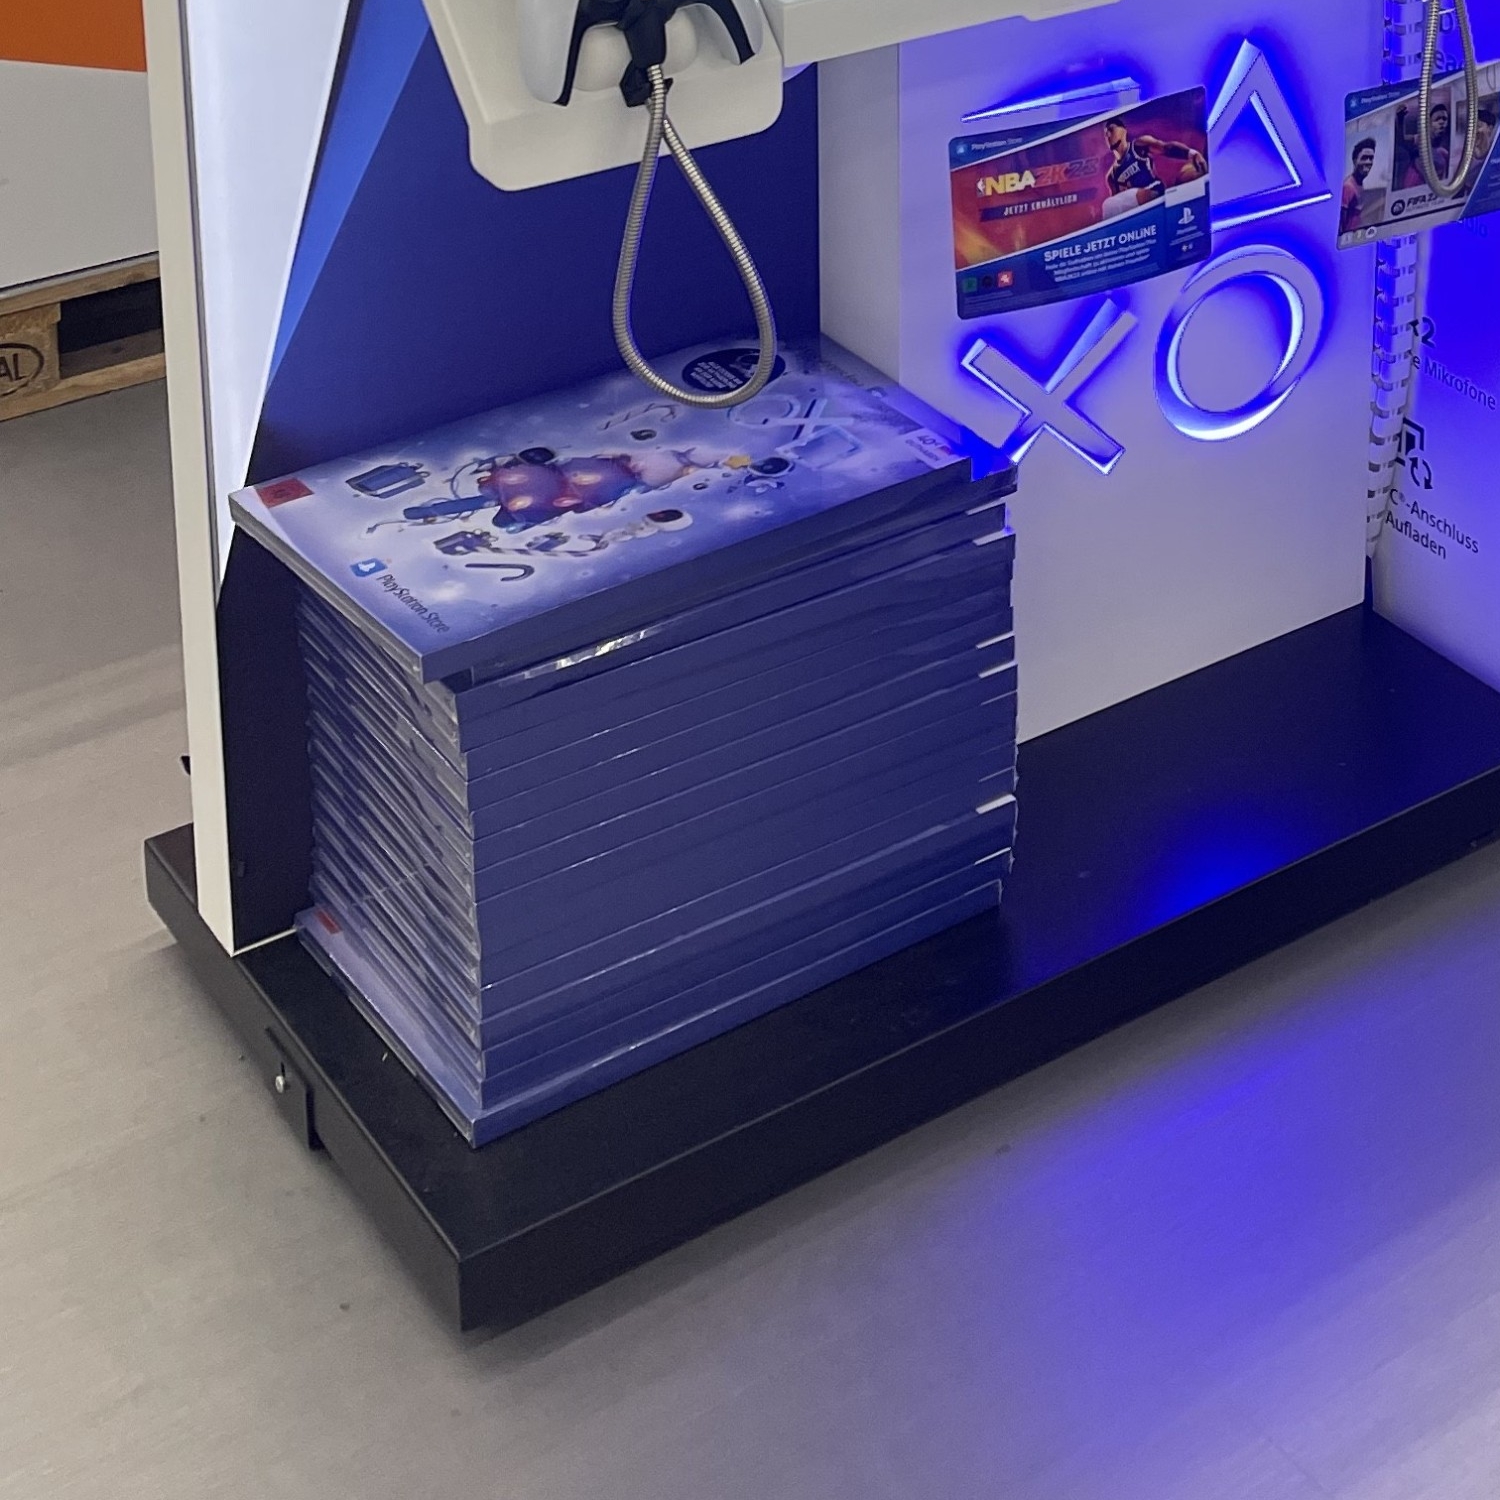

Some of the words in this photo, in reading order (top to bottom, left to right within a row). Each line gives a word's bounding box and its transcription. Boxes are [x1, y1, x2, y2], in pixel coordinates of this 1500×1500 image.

[983, 169, 1036, 197] NBA
[1043, 246, 1082, 263] SPIELE
[1083, 235, 1117, 254] JETZT
[1118, 224, 1157, 244] ONLINE
[1423, 356, 1497, 412] Mikrofone
[1385, 509, 1447, 560] Aufladen
[375, 573, 429, 616] PlayStation
[420, 611, 451, 634] Store
